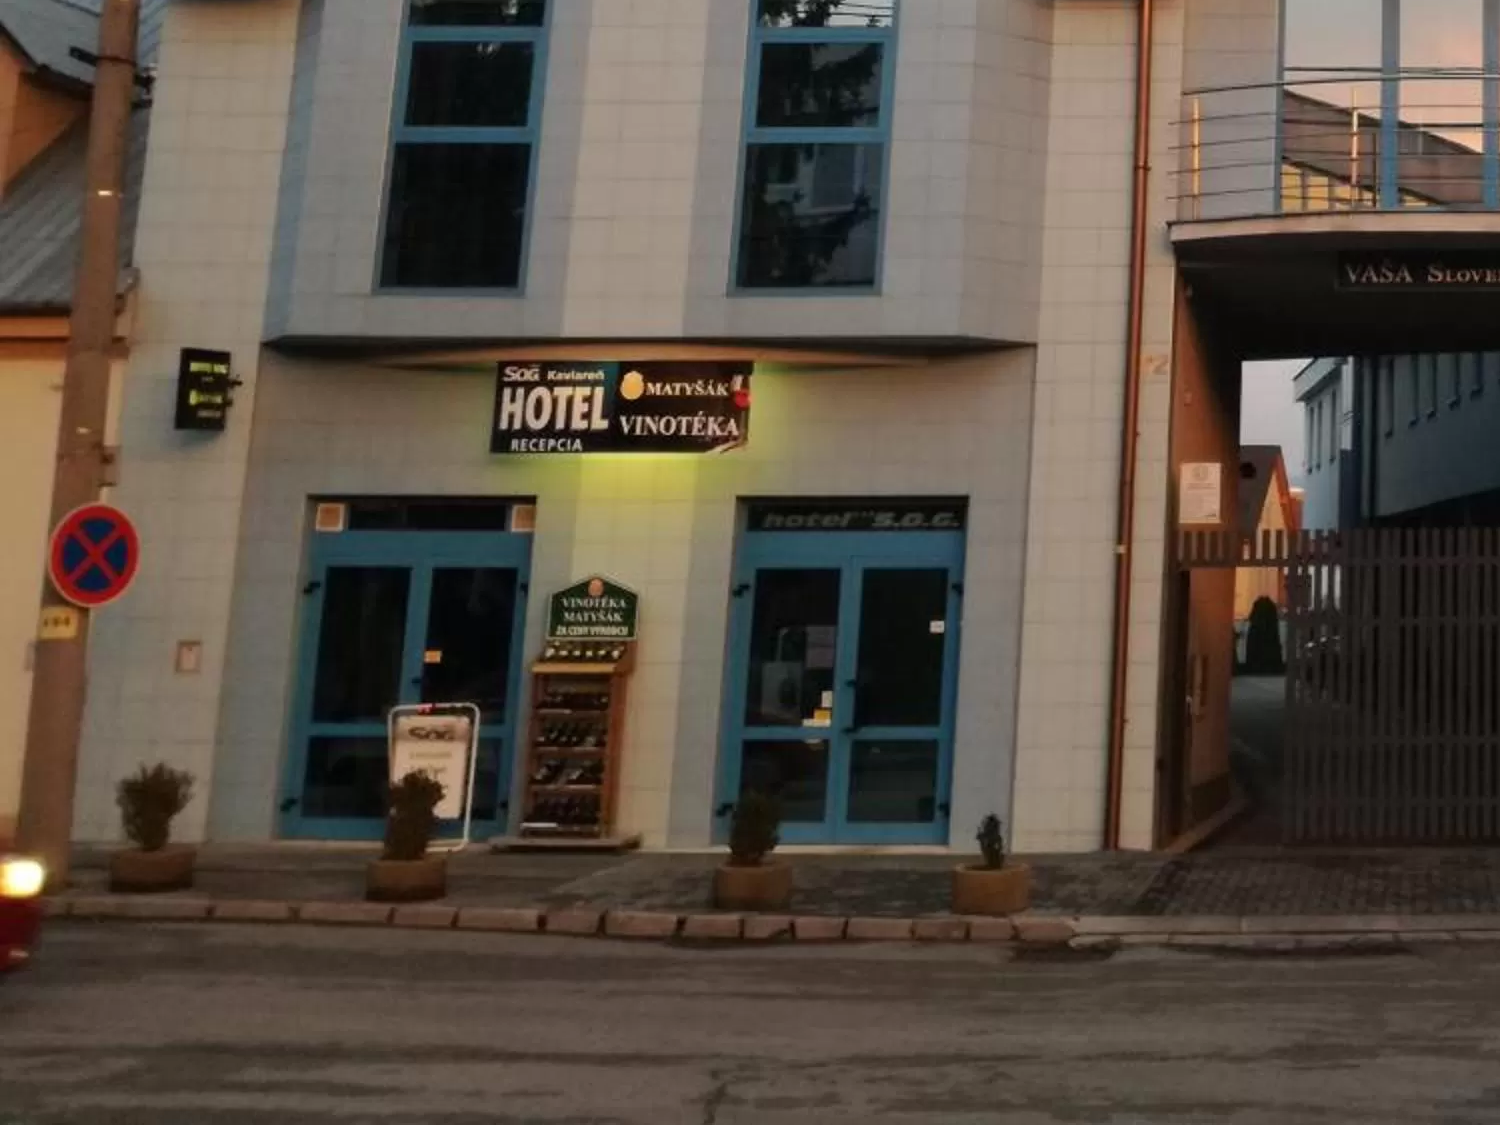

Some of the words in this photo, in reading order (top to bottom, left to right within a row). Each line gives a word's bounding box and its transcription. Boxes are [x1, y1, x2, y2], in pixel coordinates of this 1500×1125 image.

[646, 379, 730, 396] MATYŠÁK
[499, 386, 609, 431] HOTEL
[619, 410, 740, 437] VINOTÉKA
[511, 438, 583, 452] RECEPCIA
